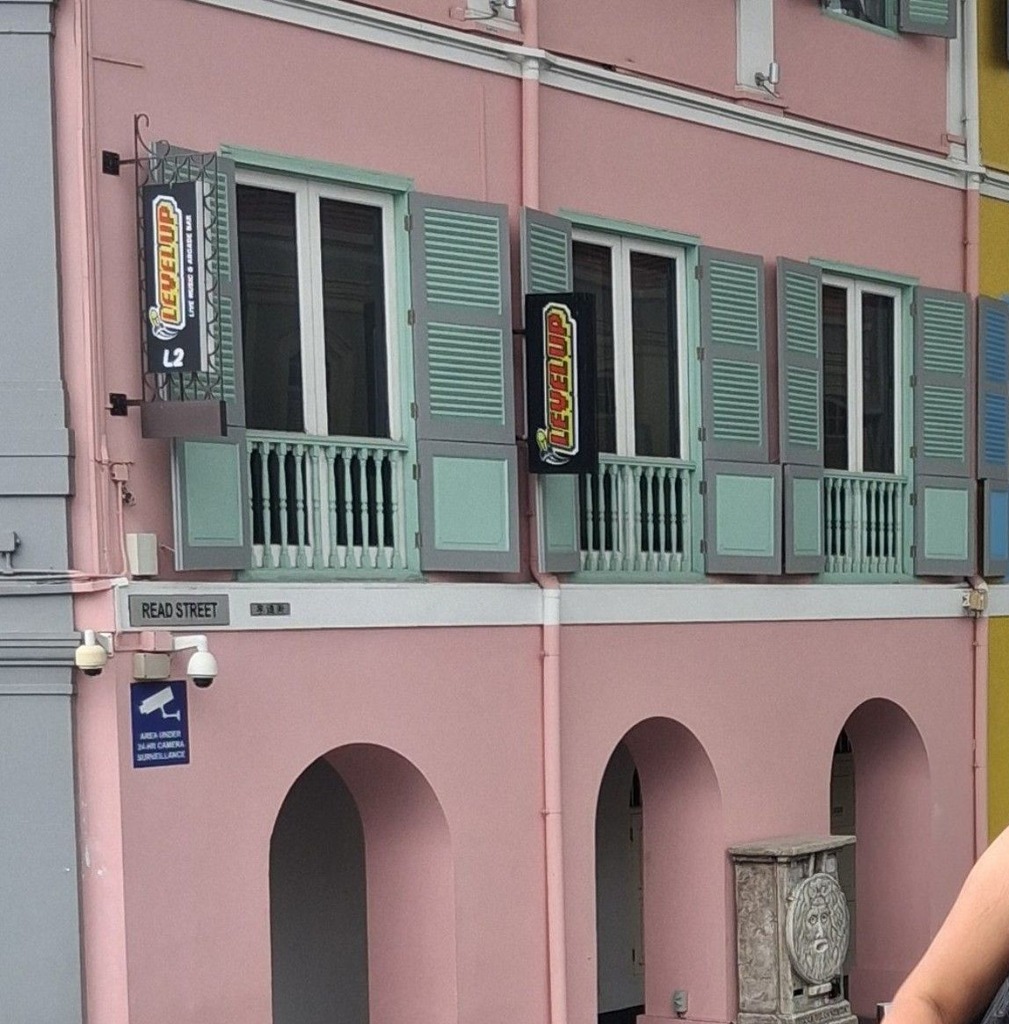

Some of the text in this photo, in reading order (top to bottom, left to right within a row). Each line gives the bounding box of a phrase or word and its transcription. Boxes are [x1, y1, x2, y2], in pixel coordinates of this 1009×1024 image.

[163, 348, 185, 368] L2
[142, 602, 218, 618] READ STREET
[140, 730, 181, 740] AREA UNDER
[157, 740, 185, 749] CAMERA
[136, 751, 186, 761] SURVEILLANCE
